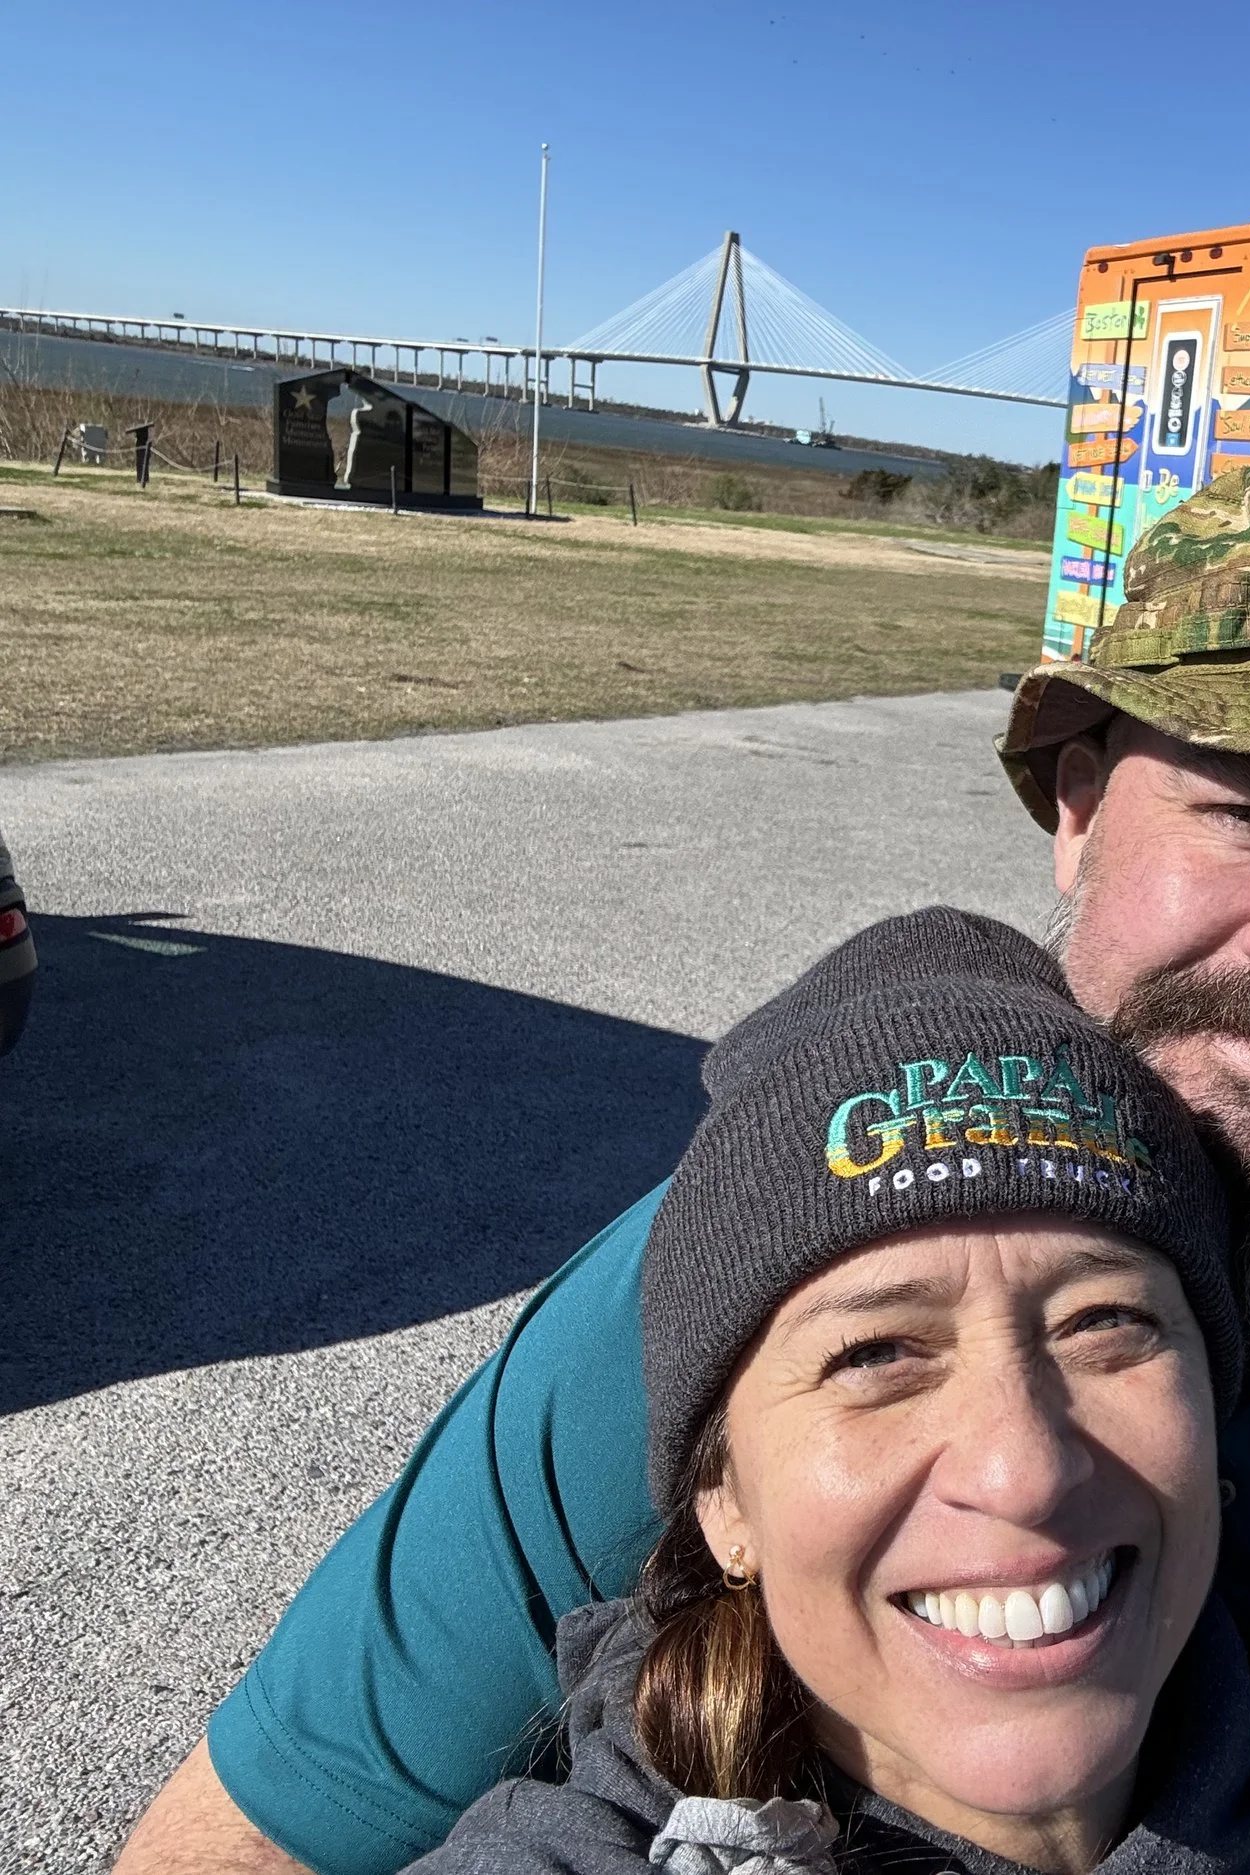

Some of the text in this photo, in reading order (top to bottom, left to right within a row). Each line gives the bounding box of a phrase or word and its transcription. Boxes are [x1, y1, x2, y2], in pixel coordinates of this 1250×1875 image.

[900, 1044, 1098, 1110] PAPÁ
[869, 1158, 1132, 1196] FOOD TRUCK
